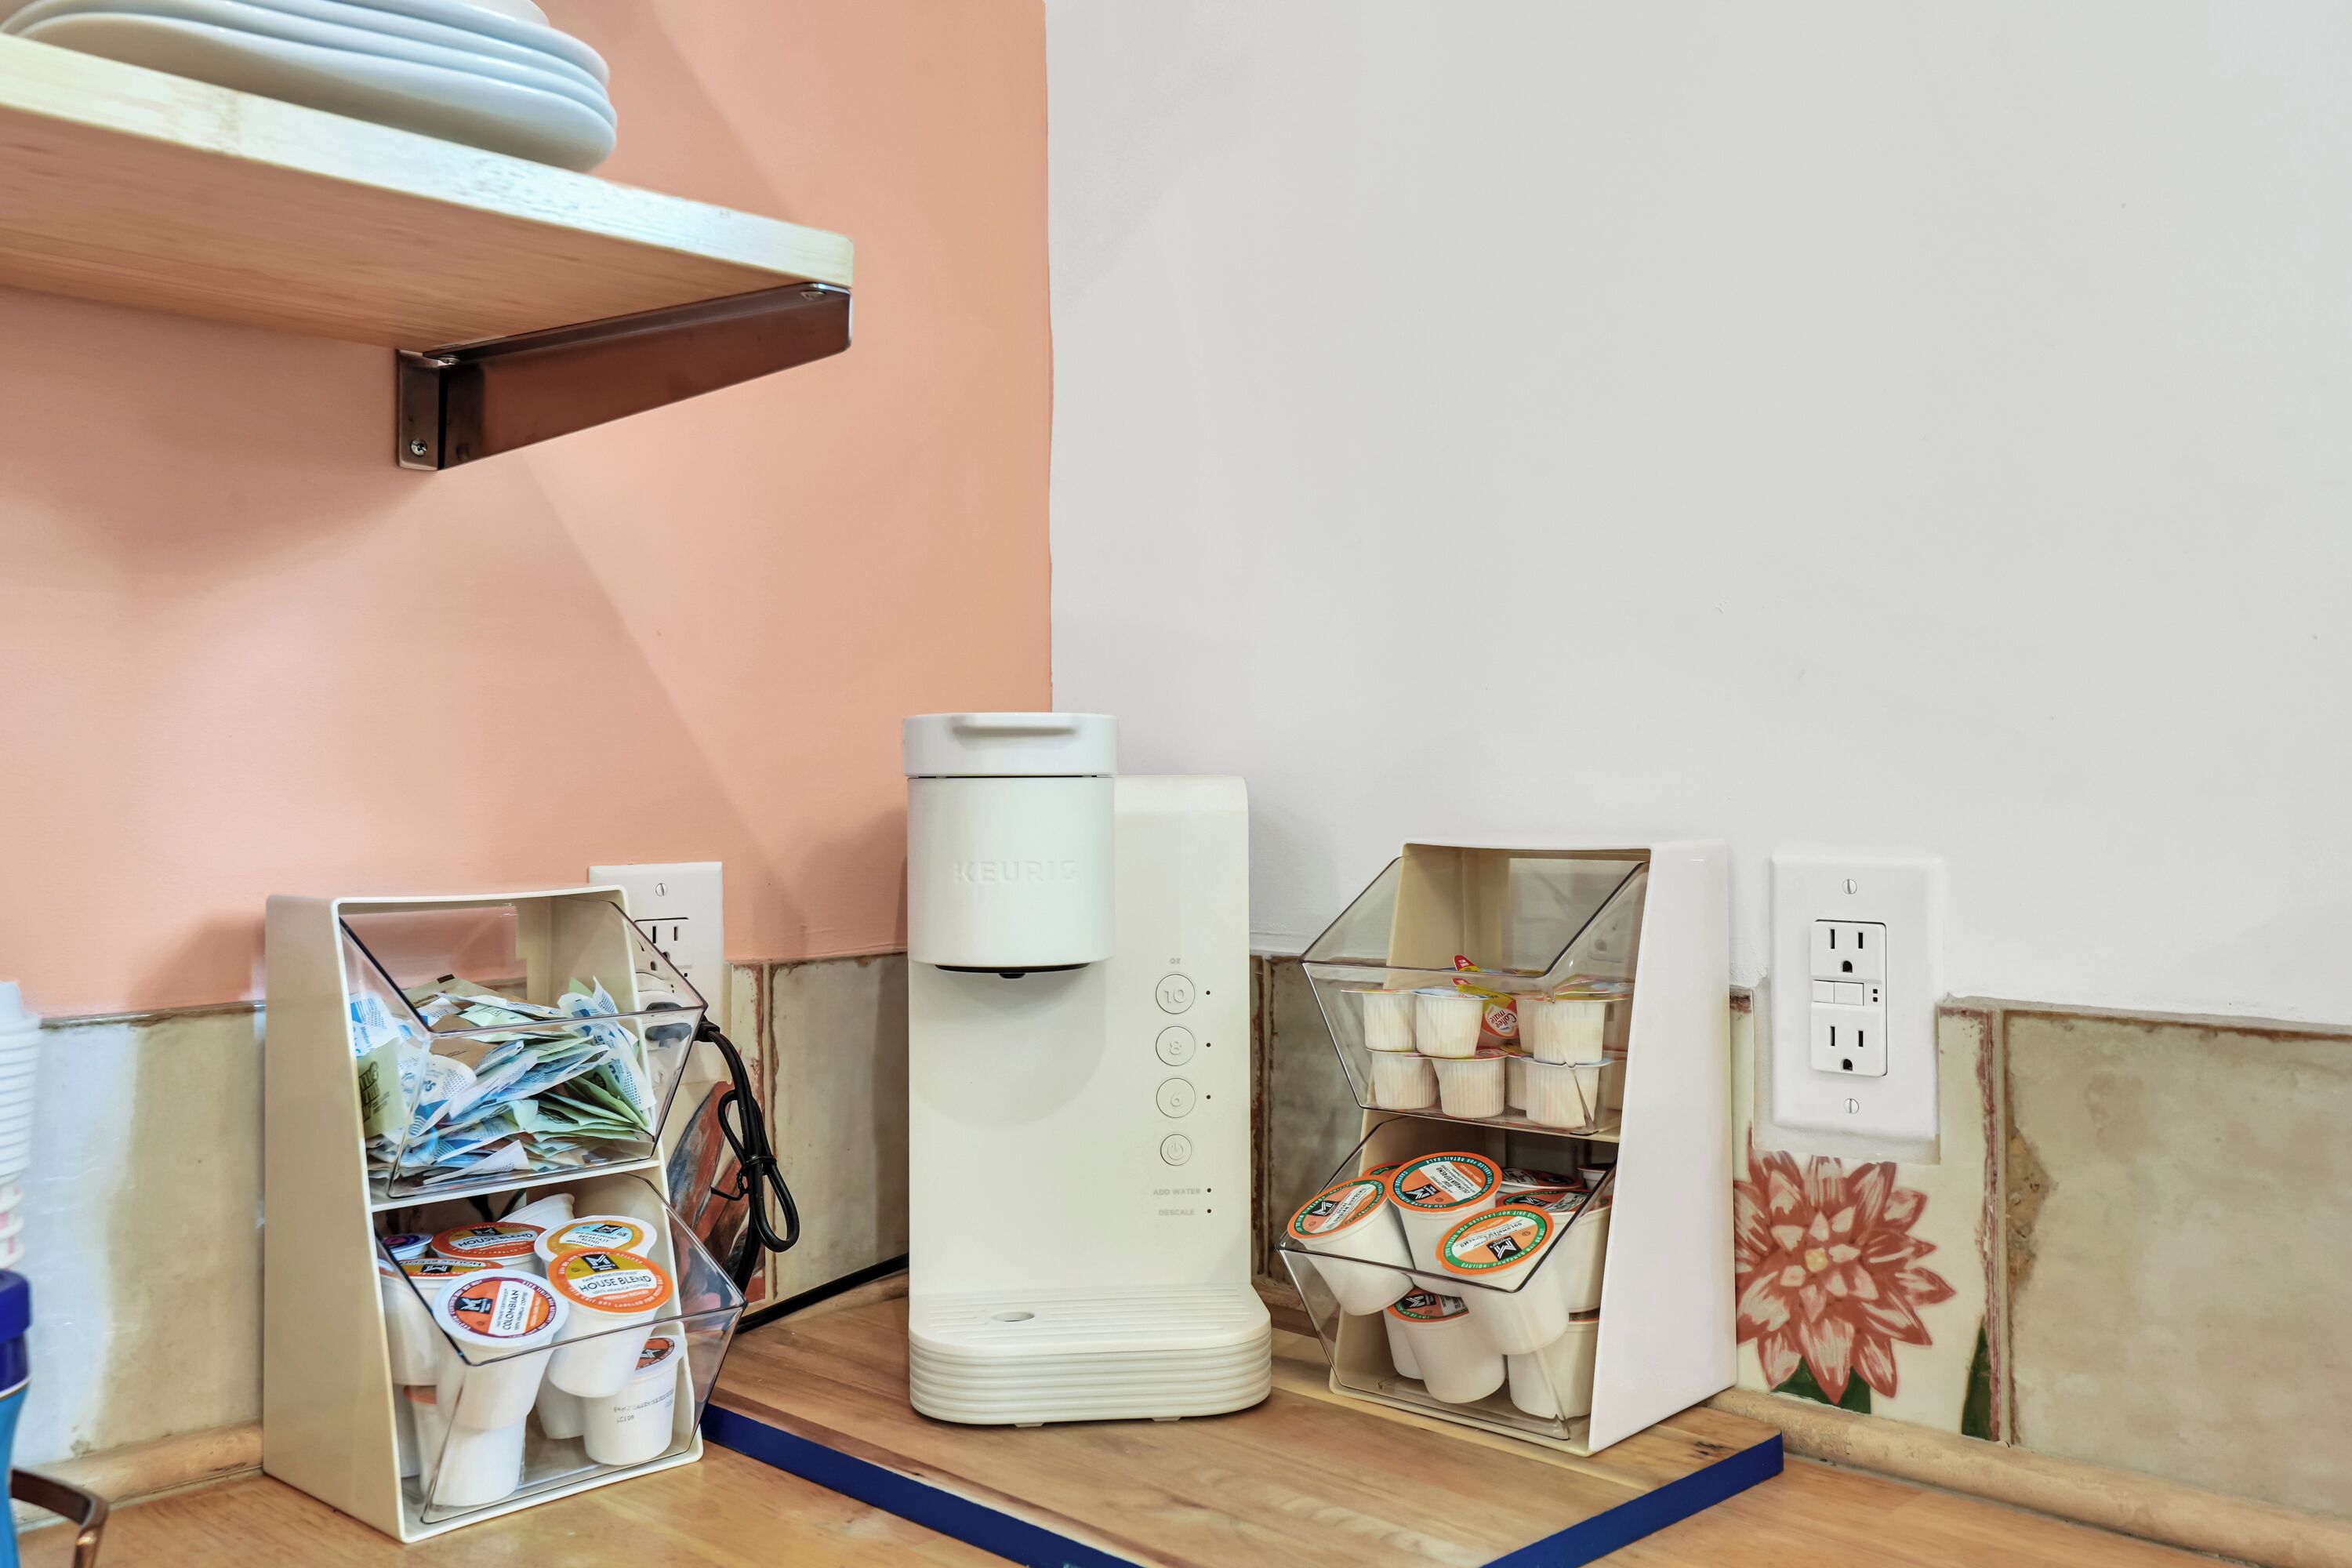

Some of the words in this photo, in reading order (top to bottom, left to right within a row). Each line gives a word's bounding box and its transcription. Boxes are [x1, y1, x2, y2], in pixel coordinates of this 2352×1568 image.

[953, 861, 1079, 884] KEURIG
[1163, 988, 1185, 1004] 10
[1489, 1009, 1506, 1024] mate
[1494, 1012, 1517, 1029] Coffee
[1169, 1040, 1181, 1055] 8
[1169, 1091, 1181, 1107] 6
[458, 1236, 497, 1247] HOUSE
[578, 1234, 610, 1243] BREAKFAST
[579, 1278, 618, 1292] HOUSE
[619, 1275, 652, 1286] BLEND
[502, 1289, 520, 1331] COLOMBIAN
